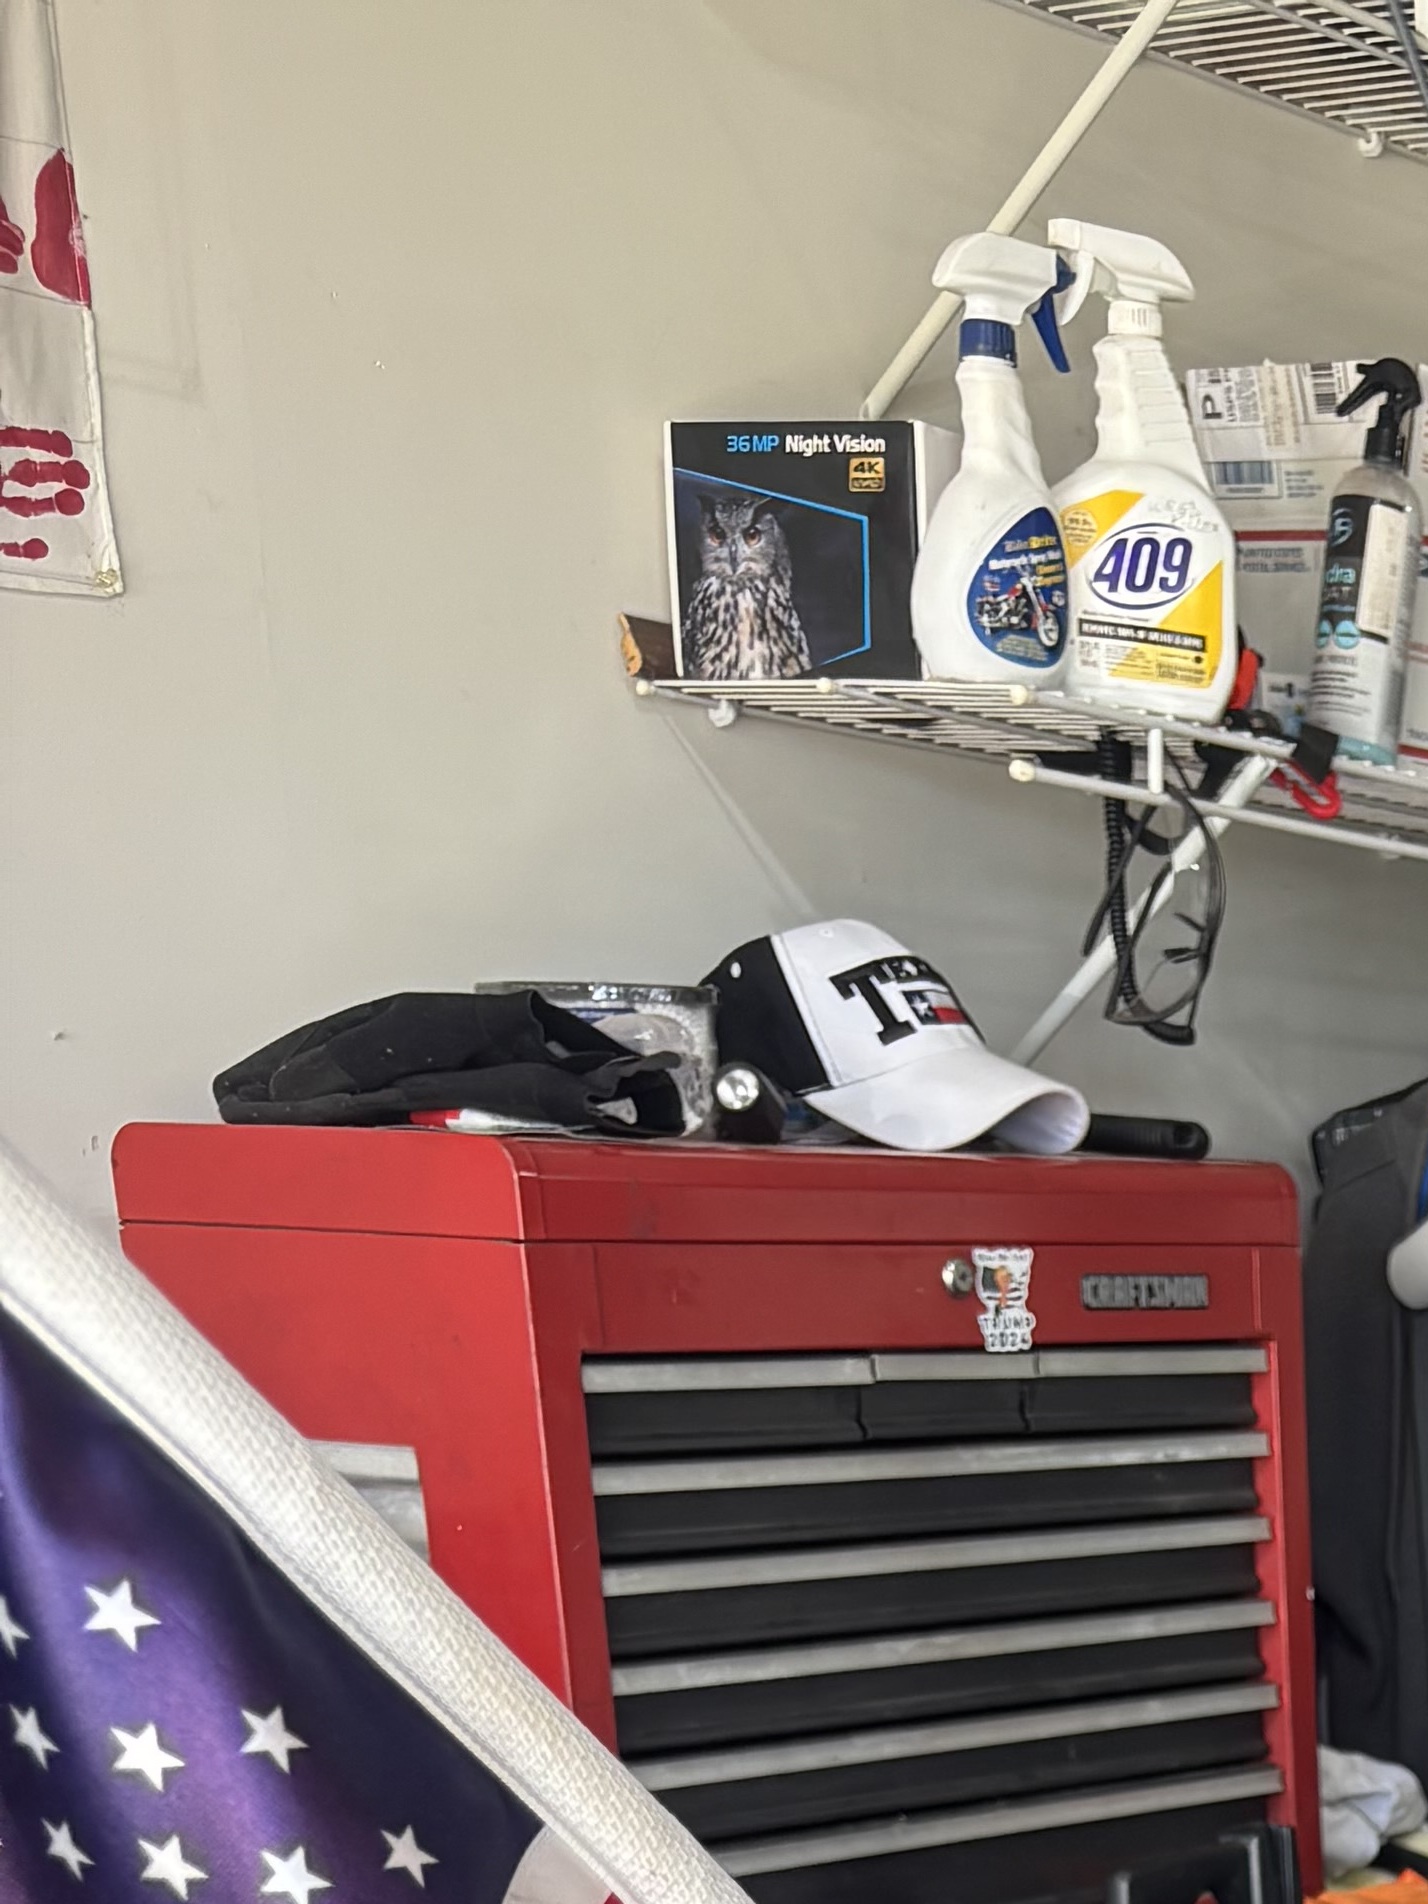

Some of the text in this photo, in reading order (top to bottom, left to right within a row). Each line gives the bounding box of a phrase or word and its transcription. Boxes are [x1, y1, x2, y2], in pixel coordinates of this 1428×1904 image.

[785, 434, 831, 456] Night
[833, 434, 886, 453] Vision
[853, 461, 880, 474] 4K
[1092, 537, 1193, 593] 409
